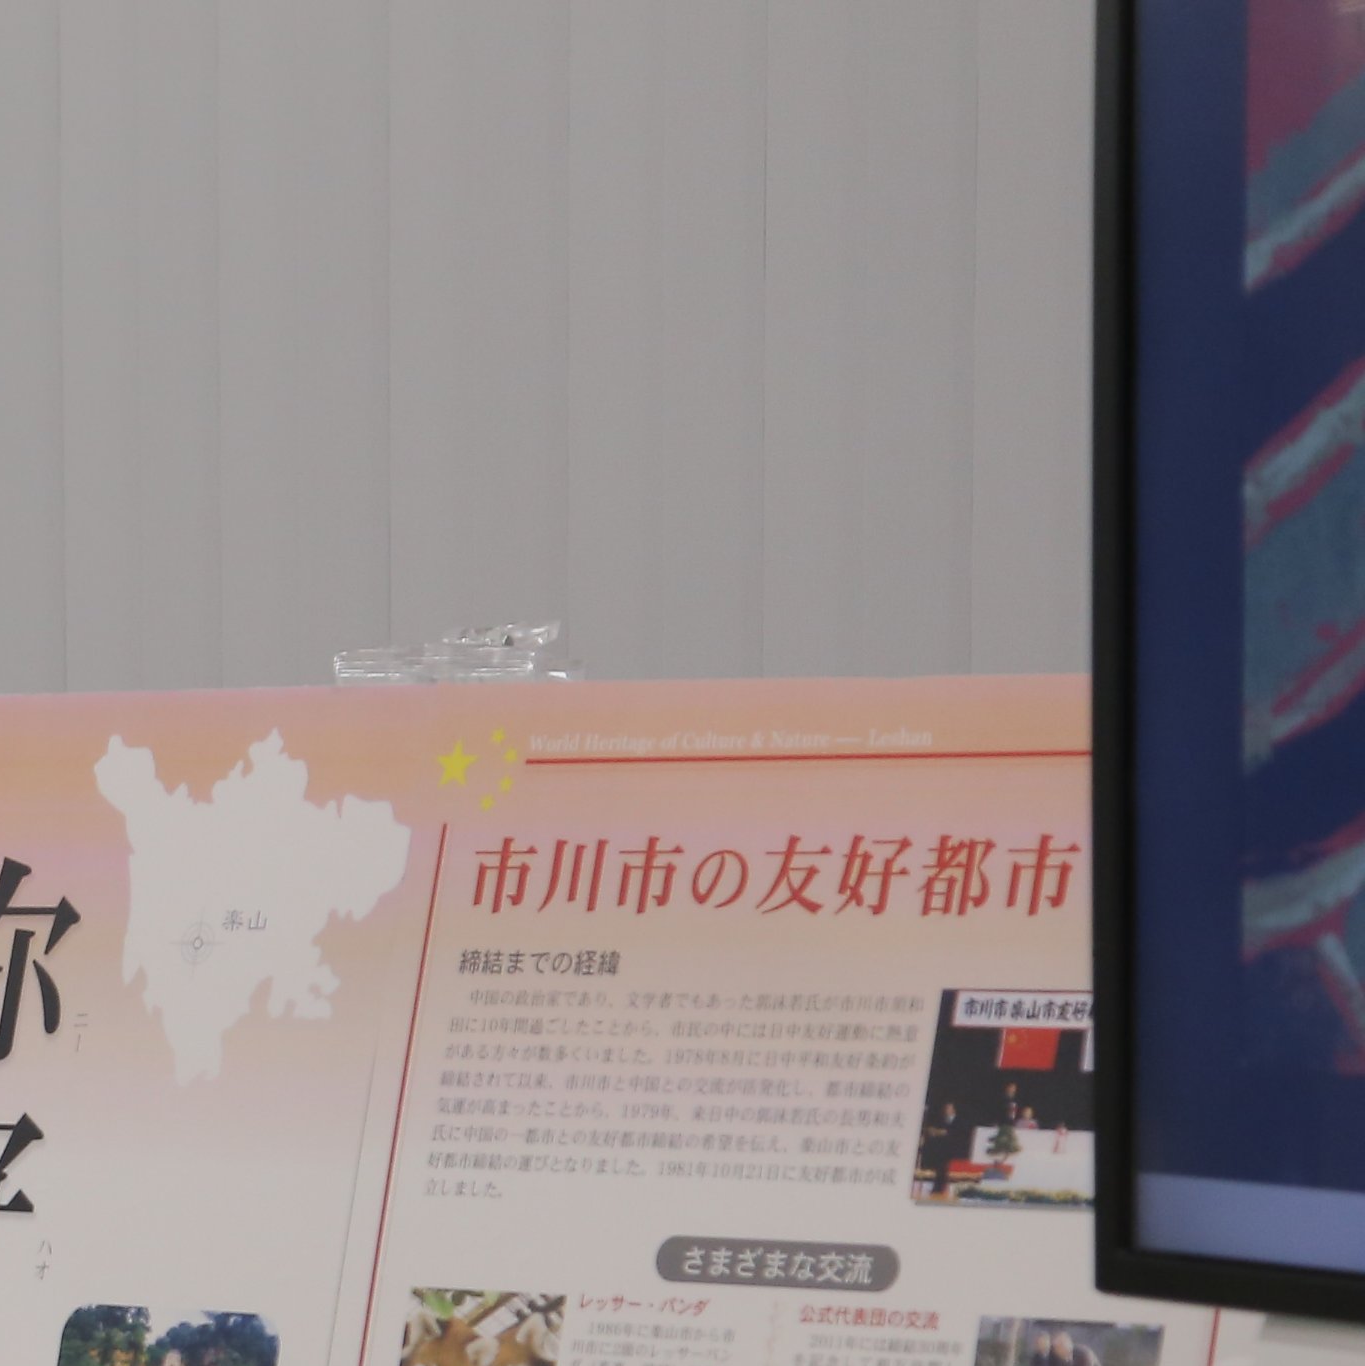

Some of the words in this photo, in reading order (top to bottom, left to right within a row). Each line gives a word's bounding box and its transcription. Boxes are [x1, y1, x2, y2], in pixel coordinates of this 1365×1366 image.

[471, 833, 1081, 918] 市川市の友好都市
[222, 908, 268, 932] 楽山
[459, 949, 621, 977] 締結までの経緯
[682, 1245, 873, 1284] さまざまな交流
[799, 1304, 941, 1331] 公式代表団の交流
